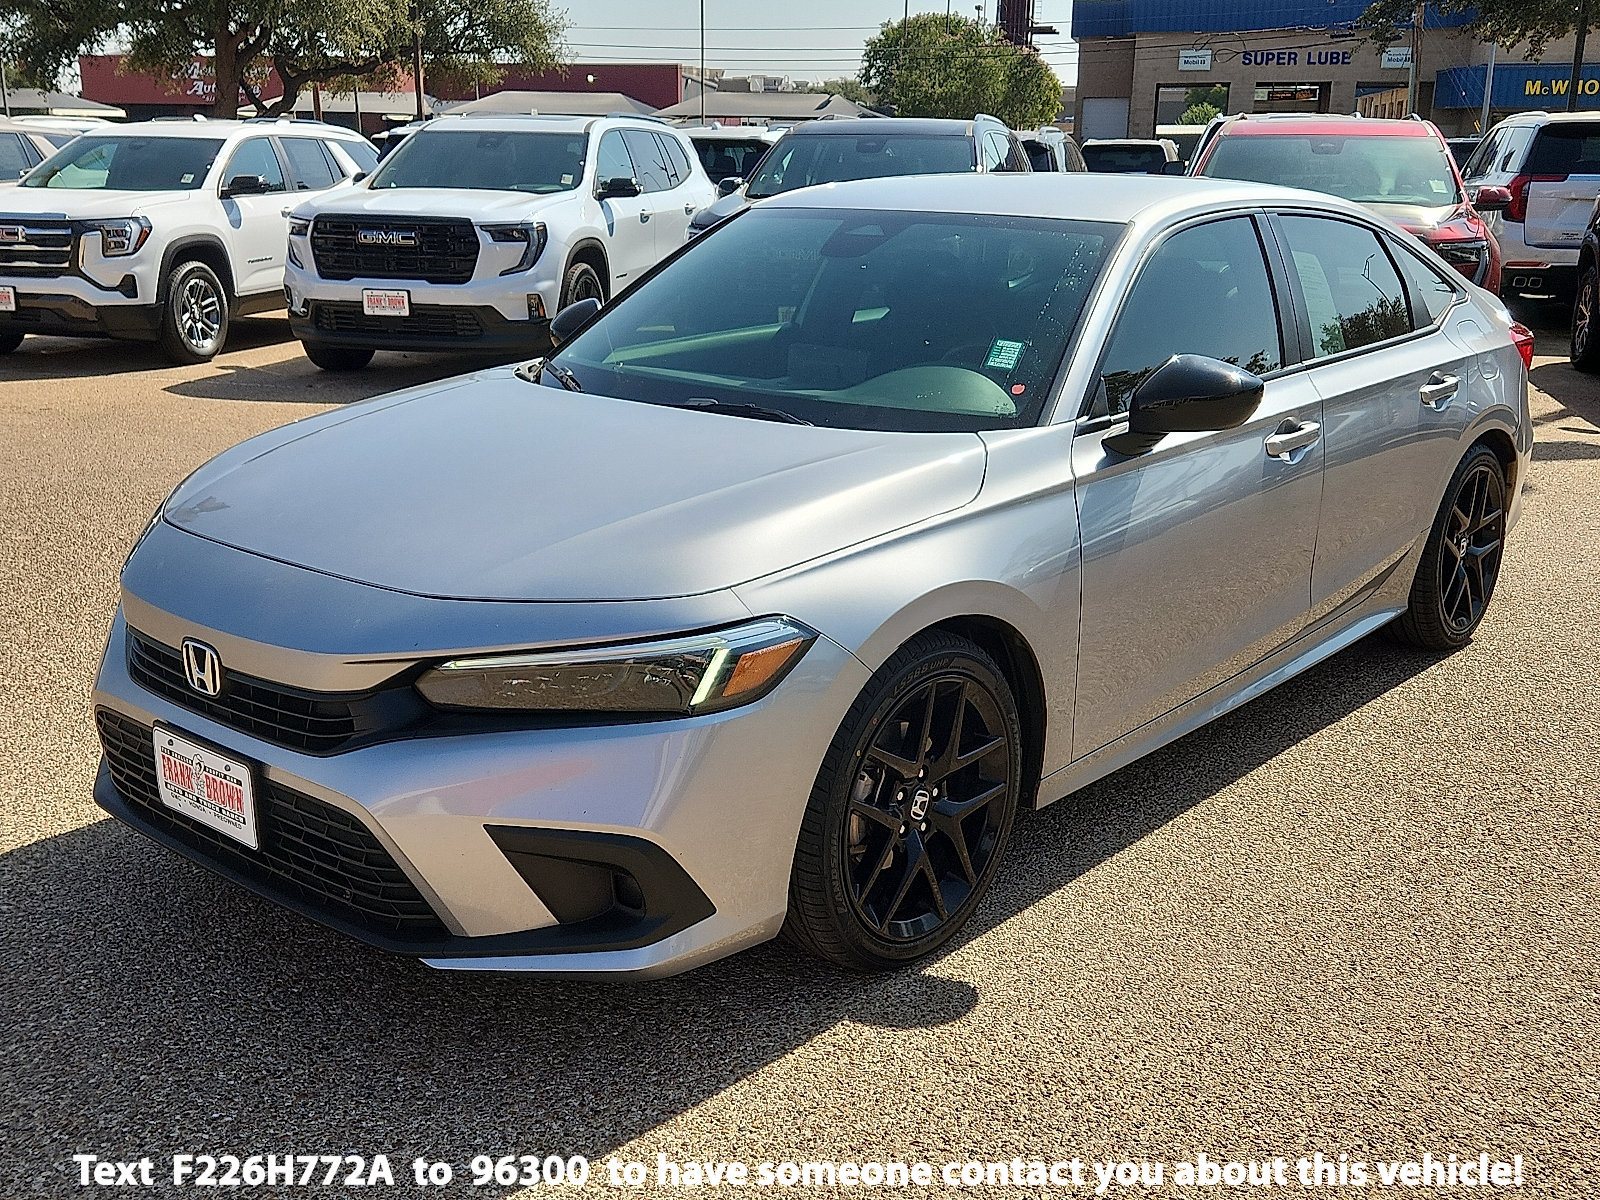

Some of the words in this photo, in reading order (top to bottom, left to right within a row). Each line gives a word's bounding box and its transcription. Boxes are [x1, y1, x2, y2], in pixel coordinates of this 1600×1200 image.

[1241, 51, 1298, 66] SUPER
[1307, 51, 1352, 65] LUBE
[357, 230, 416, 246] GMC
[161, 753, 196, 794] FRANK
[204, 773, 245, 816] BROWN
